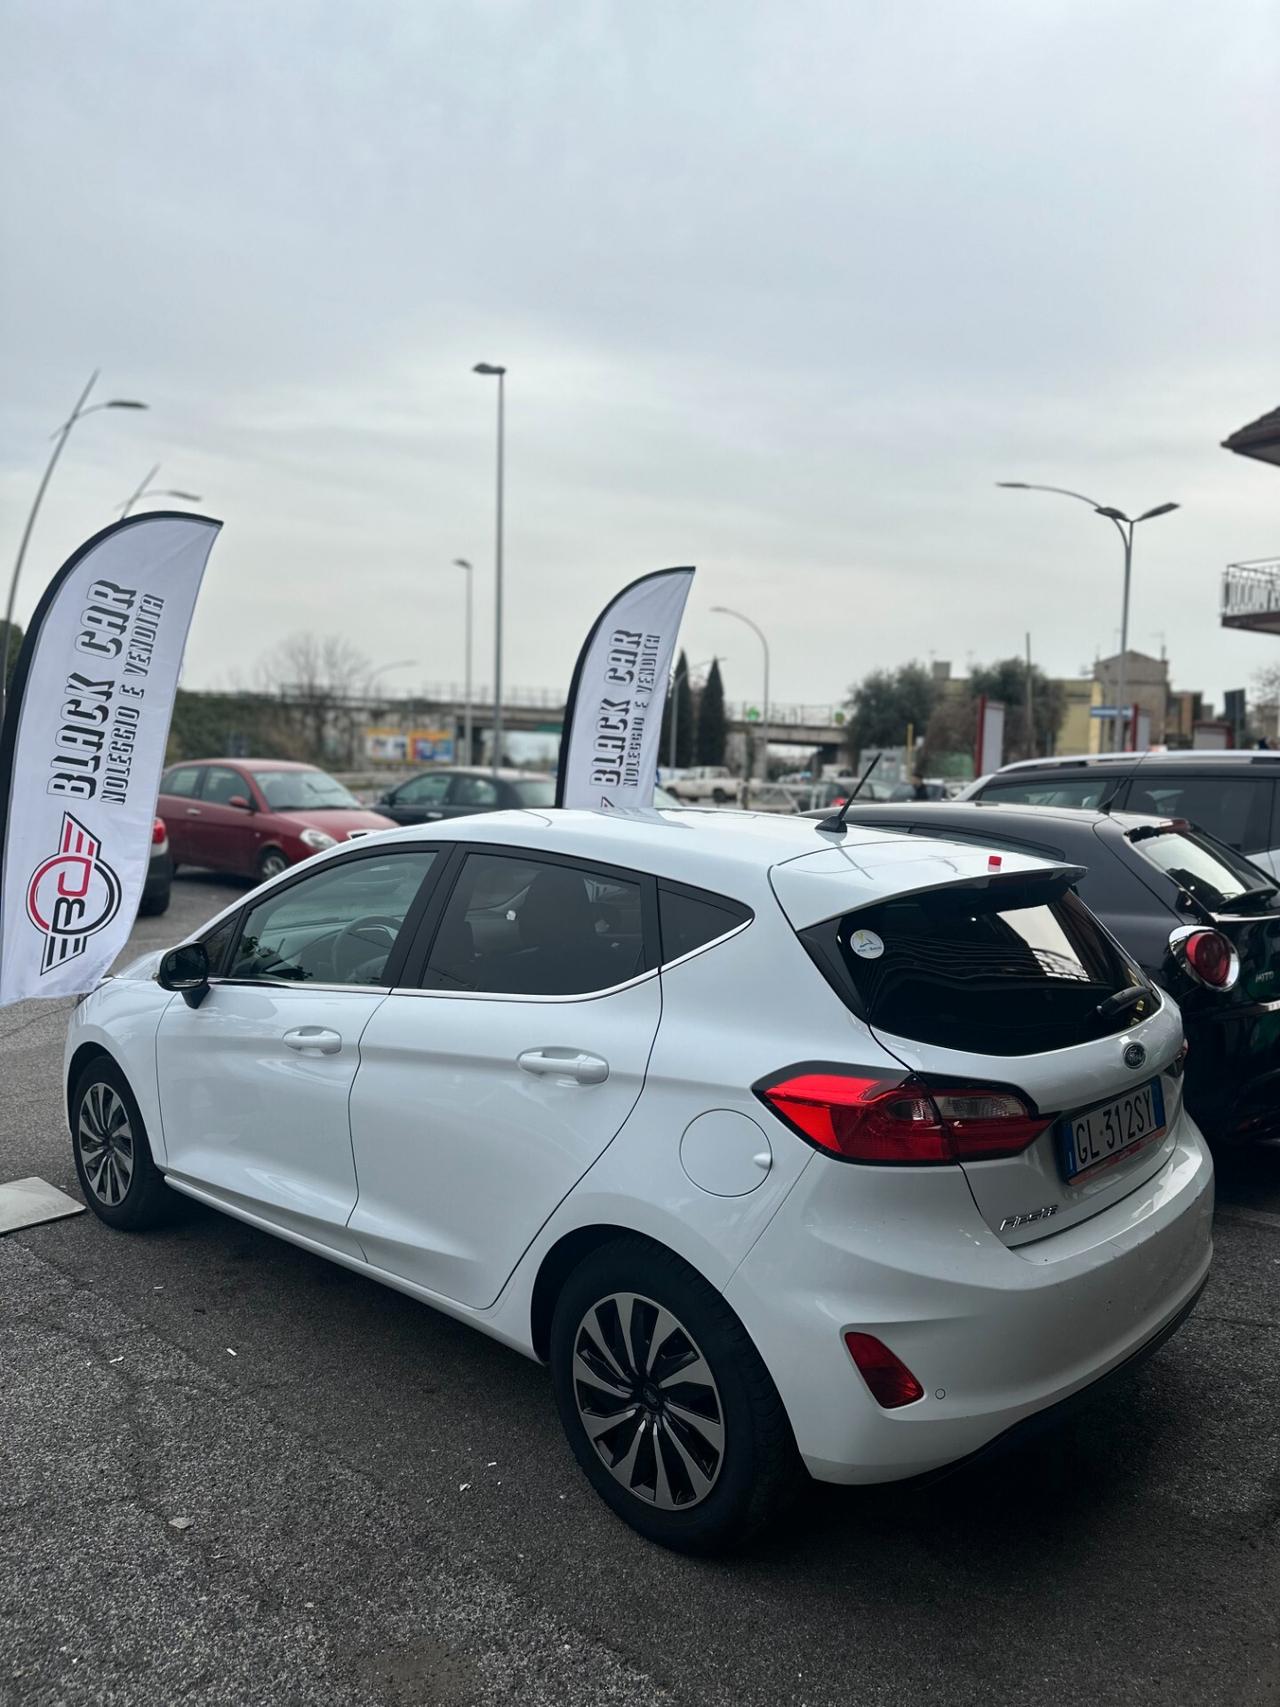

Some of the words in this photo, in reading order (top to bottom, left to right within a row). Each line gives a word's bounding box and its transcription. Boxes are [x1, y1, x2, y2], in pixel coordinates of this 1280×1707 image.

[75, 579, 137, 660] CAR
[123, 593, 165, 677] VENDITA
[604, 629, 643, 688] CAR
[119, 684, 145, 700] E
[46, 672, 115, 801] BLACK
[101, 705, 140, 806] NOLEGGIO
[590, 698, 631, 788] BLACK
